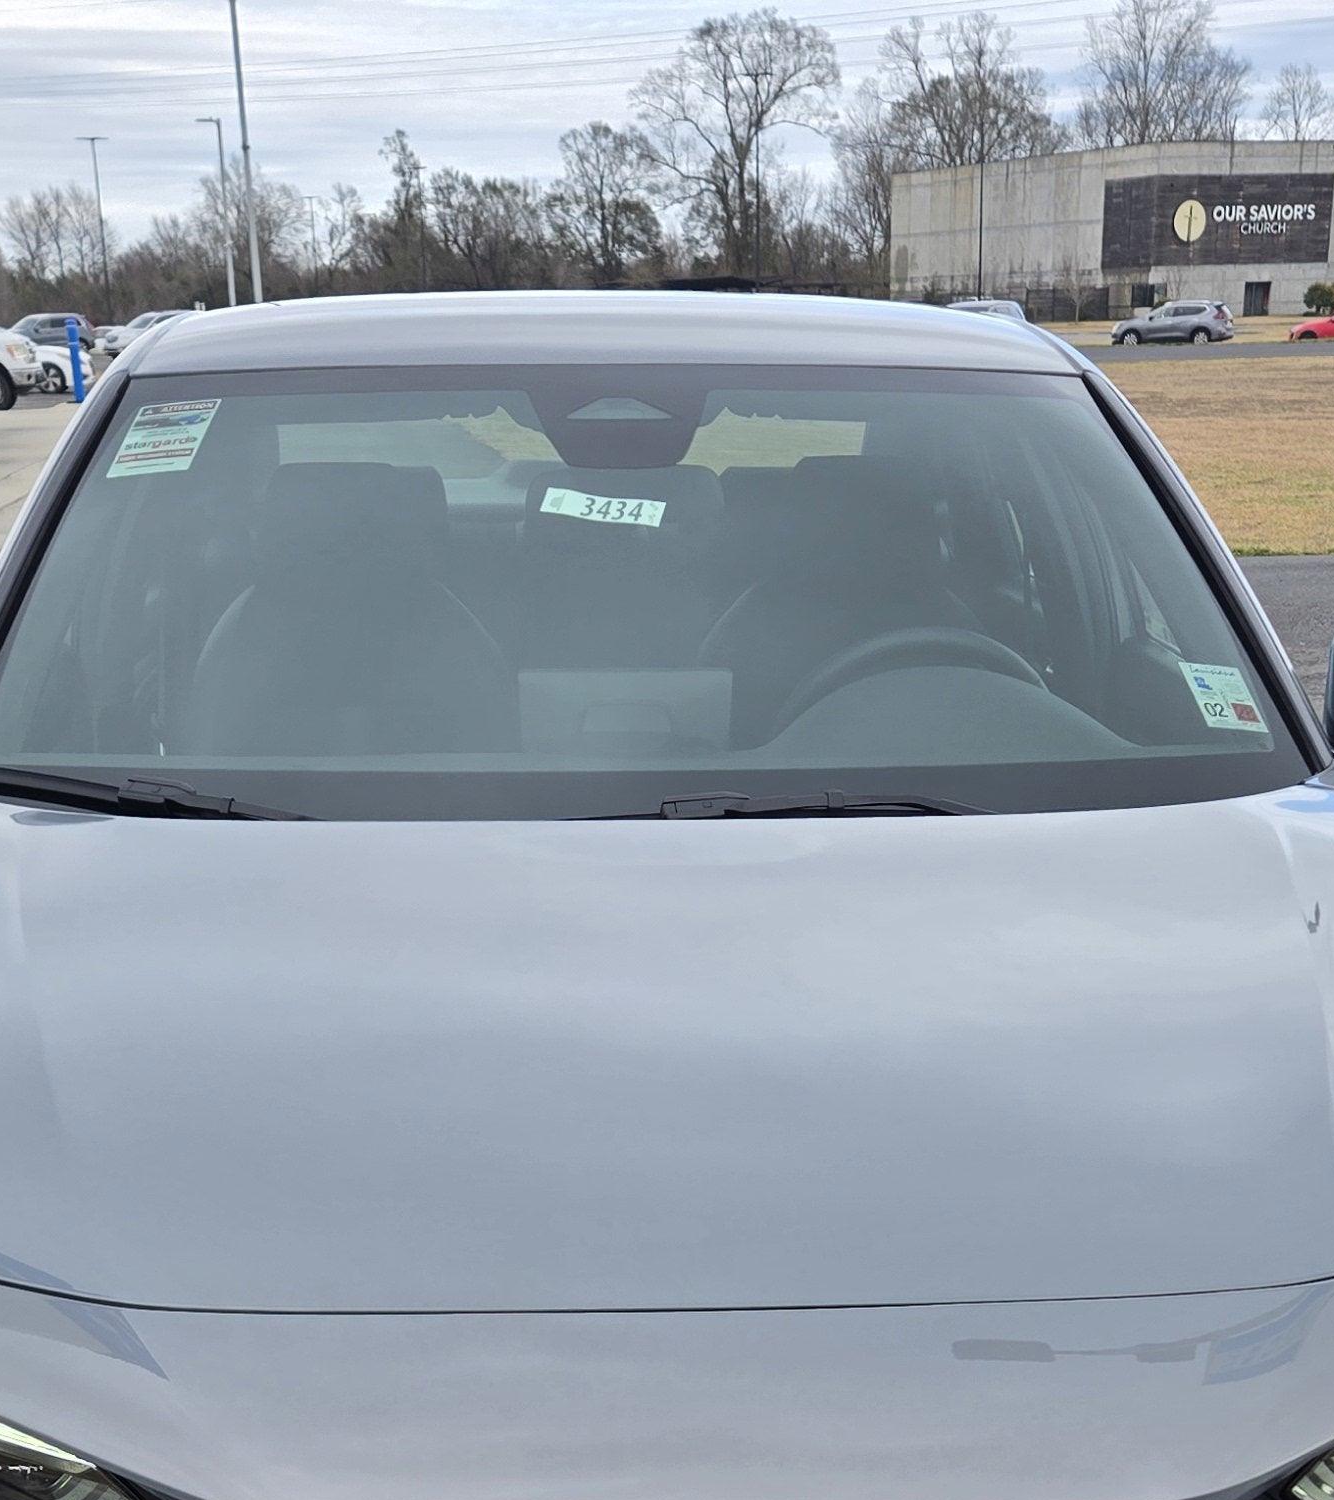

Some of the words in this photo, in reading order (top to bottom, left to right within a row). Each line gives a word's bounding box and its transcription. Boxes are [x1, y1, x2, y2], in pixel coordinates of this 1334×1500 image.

[1213, 205, 1246, 221] OUR
[1249, 204, 1316, 221] SAVIOR'S
[1241, 222, 1286, 234] CHURCH
[580, 497, 643, 521] 3434
[1203, 702, 1229, 718] 02
